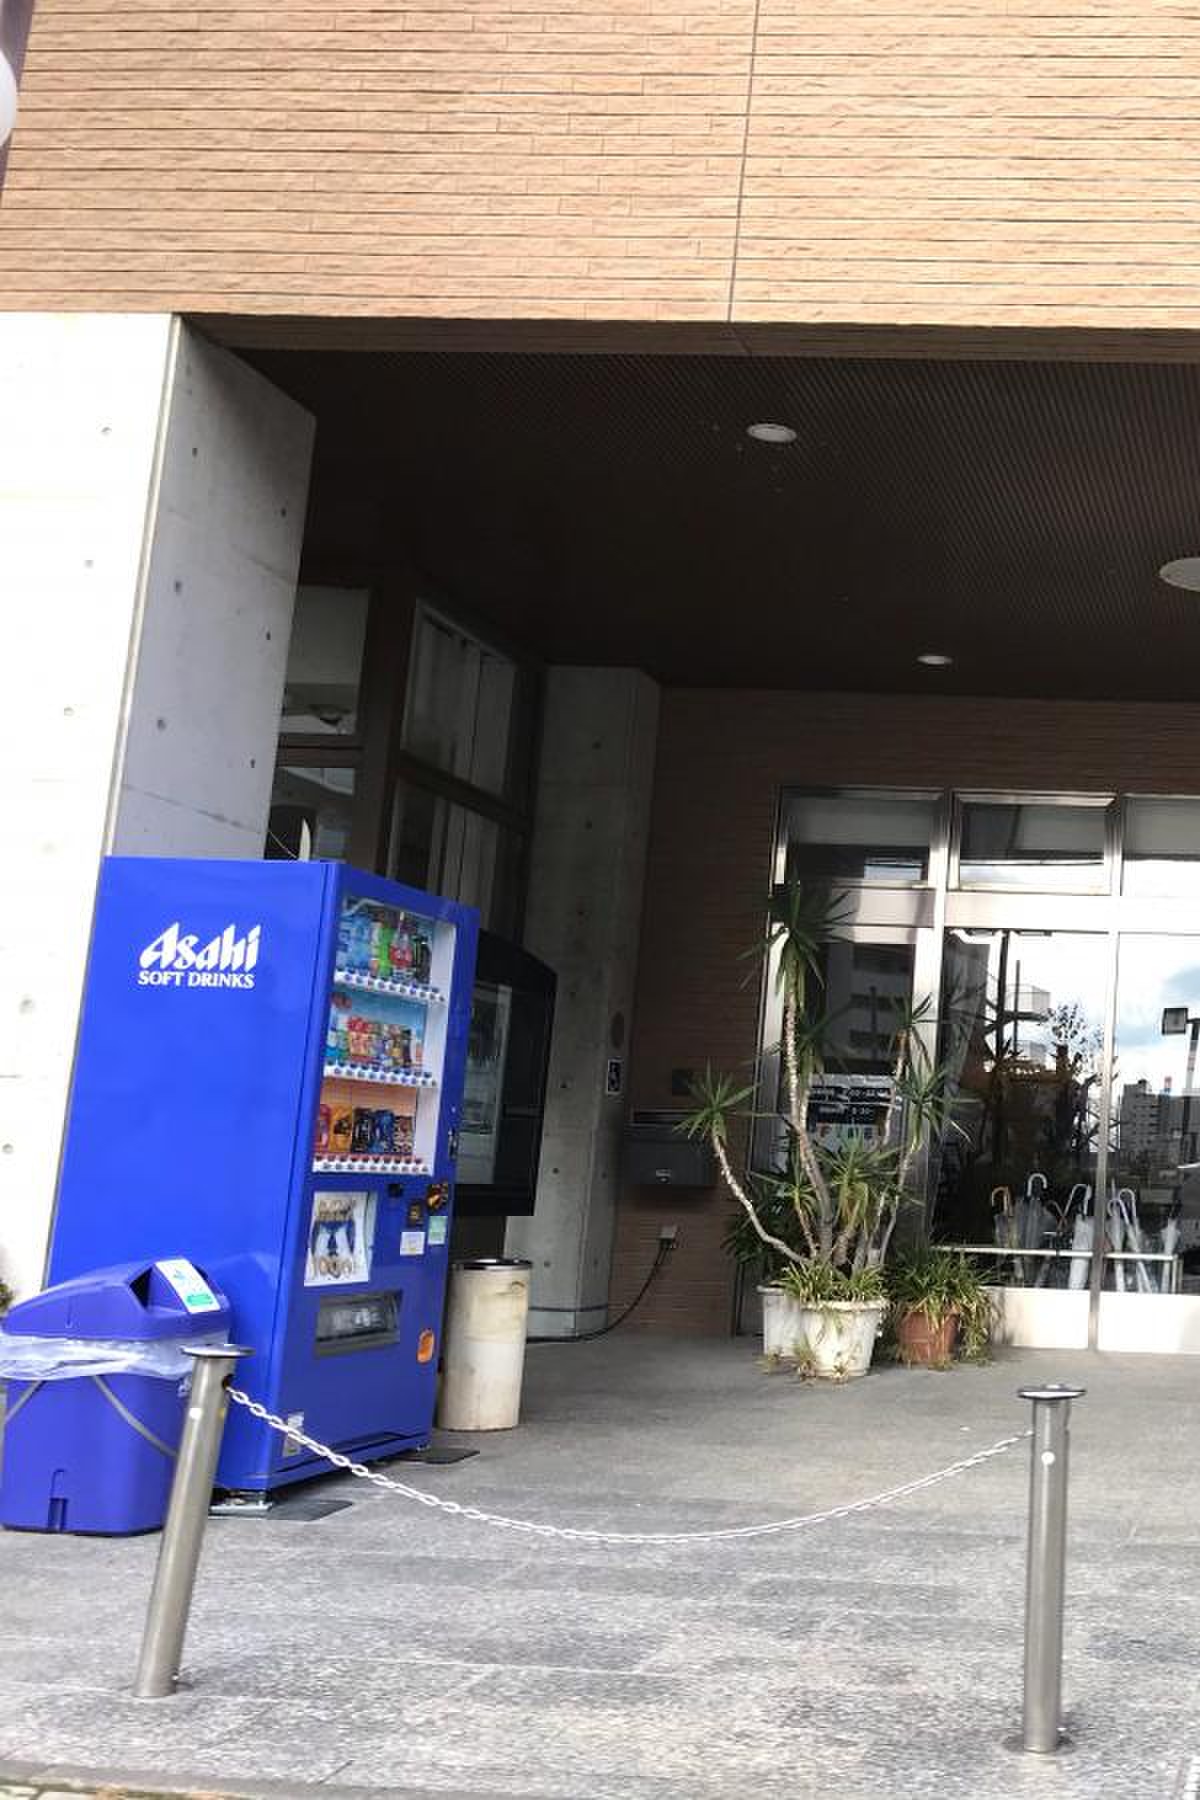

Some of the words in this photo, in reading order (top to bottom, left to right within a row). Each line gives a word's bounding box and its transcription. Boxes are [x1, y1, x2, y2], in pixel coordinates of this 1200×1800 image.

[138, 921, 262, 972] Asahi
[137, 970, 185, 987] SOFT
[187, 971, 256, 989] DRINKS
